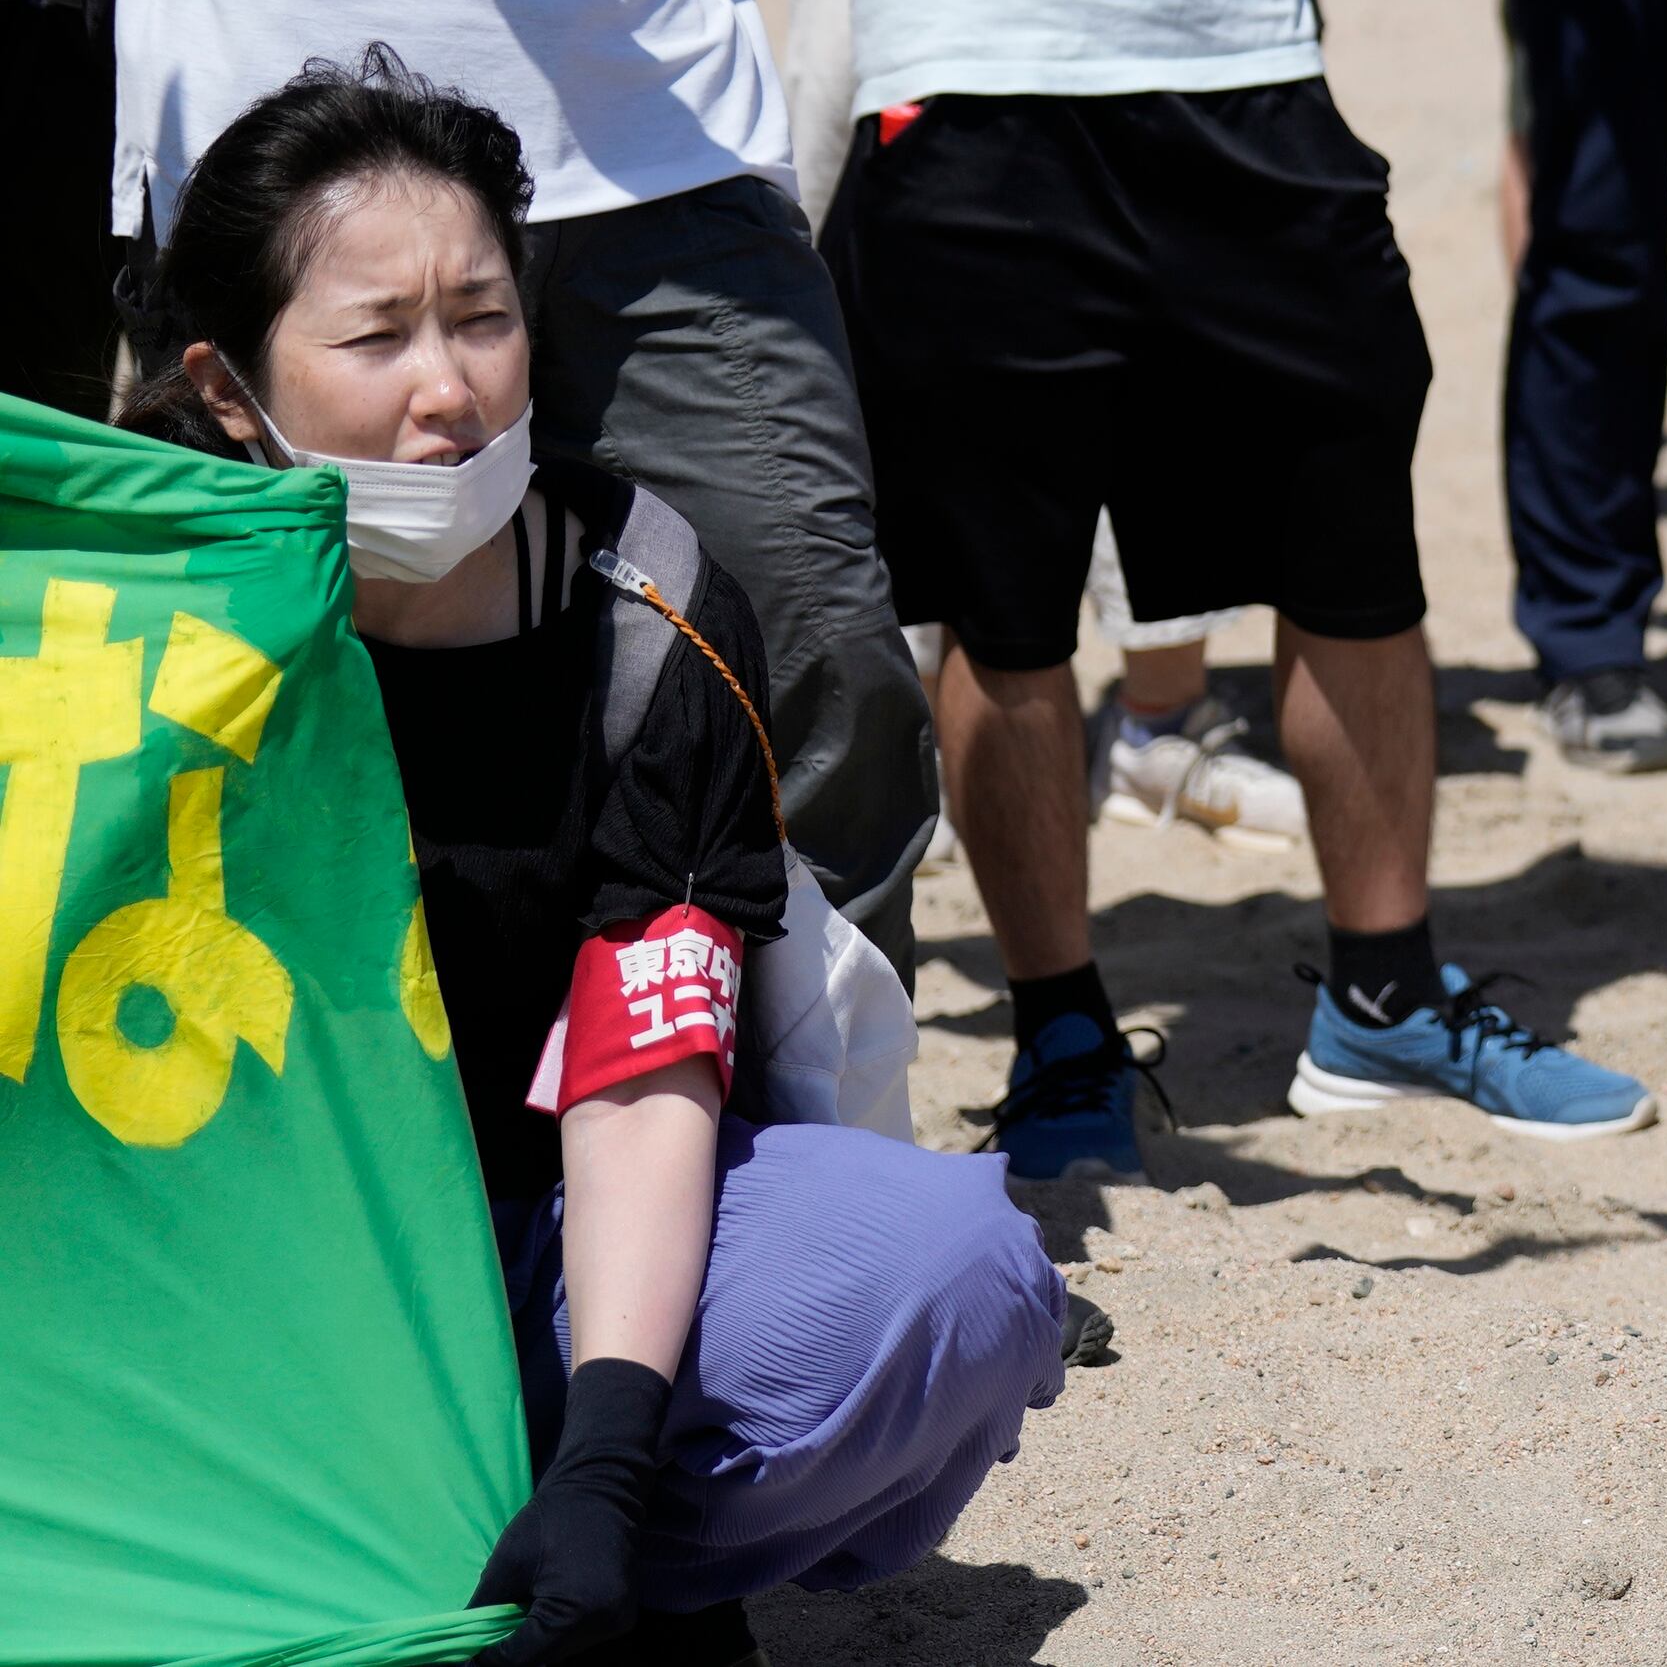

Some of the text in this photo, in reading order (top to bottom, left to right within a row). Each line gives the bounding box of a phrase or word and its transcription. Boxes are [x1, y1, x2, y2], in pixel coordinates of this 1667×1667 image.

[0, 579, 450, 1149] な
[616, 928, 741, 1011] 東京中
[629, 984, 735, 1066] ユニオ
